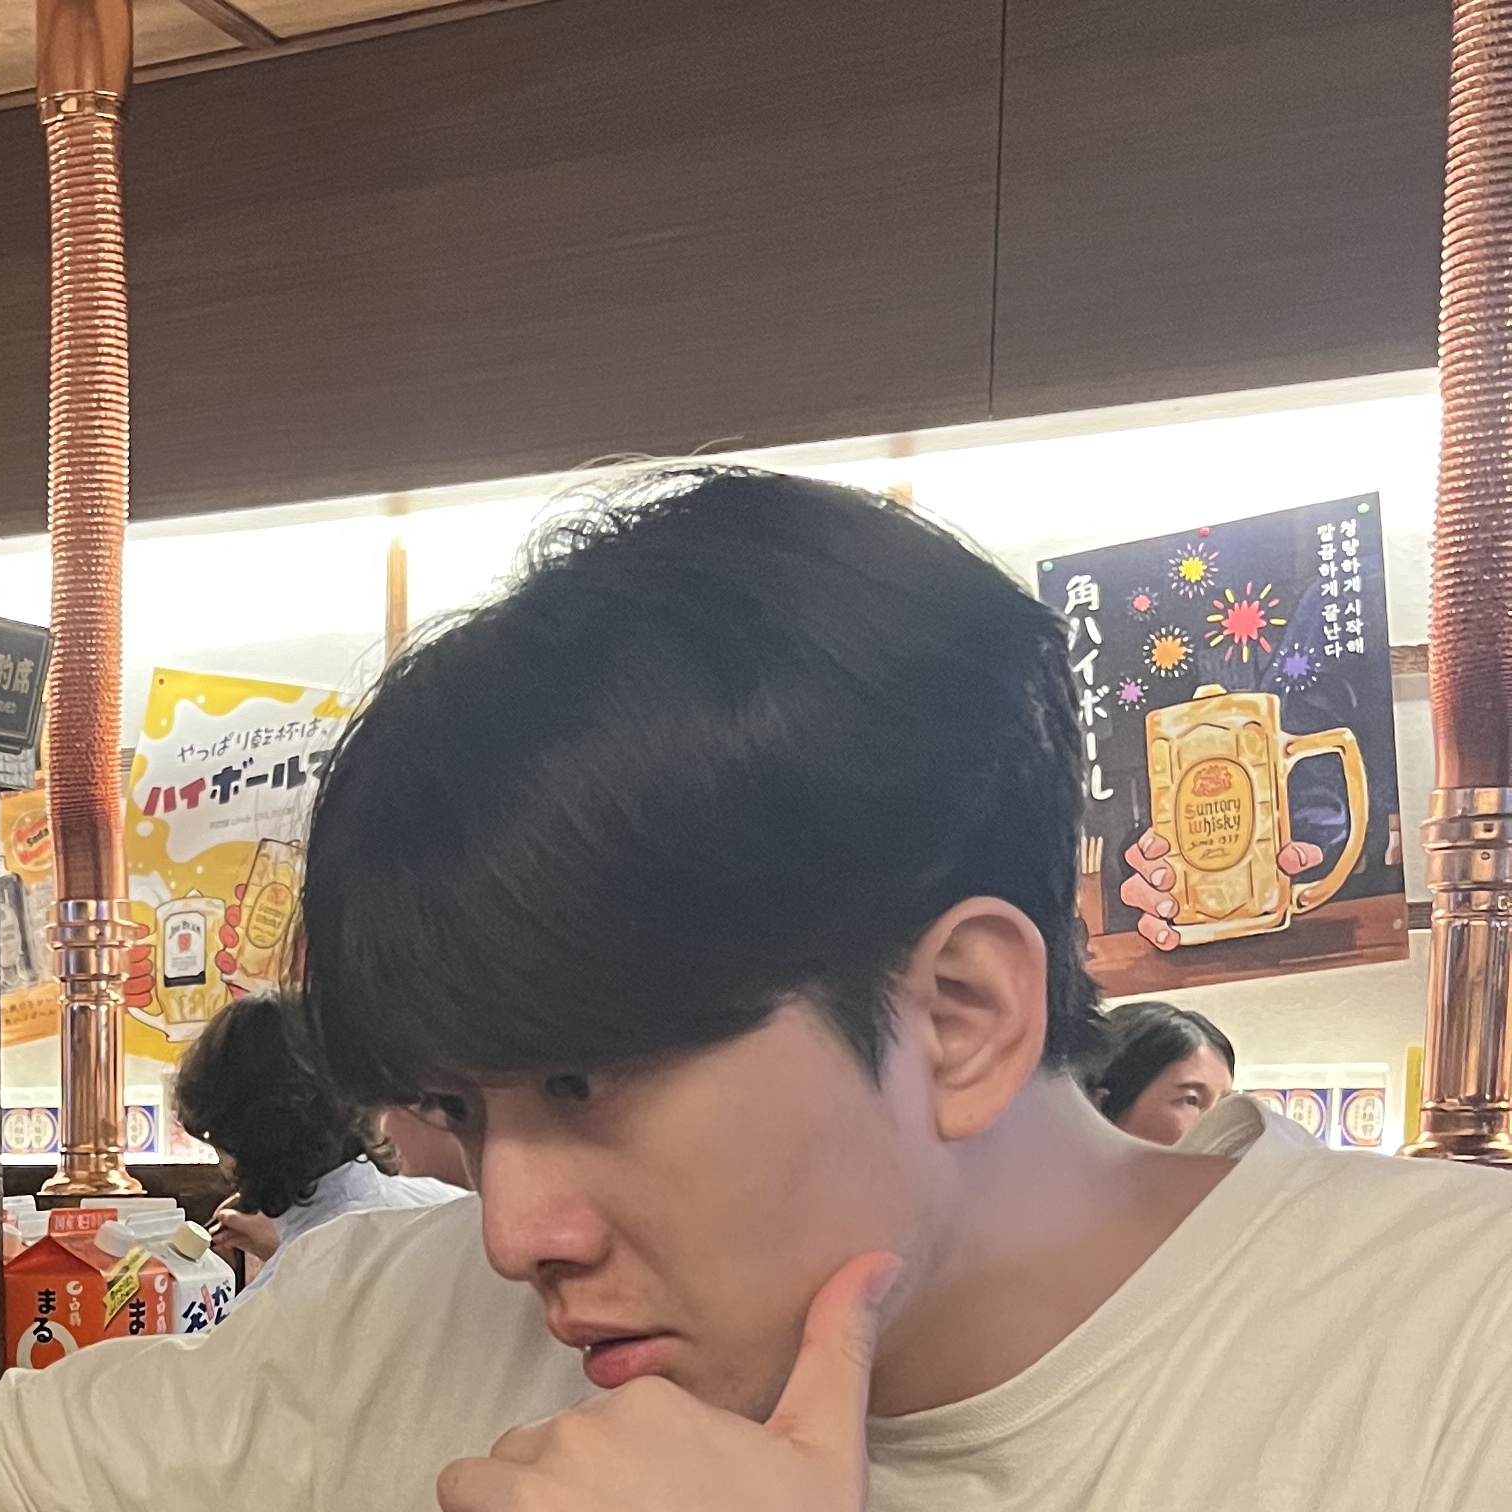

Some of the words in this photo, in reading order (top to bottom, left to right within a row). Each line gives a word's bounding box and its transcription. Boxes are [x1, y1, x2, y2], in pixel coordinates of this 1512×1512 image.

[1344, 599, 1364, 654] 시작해
[1064, 574, 1115, 801] 角ハイボール
[1184, 799, 1241, 820] Suntory
[32, 1287, 57, 1344] まる
